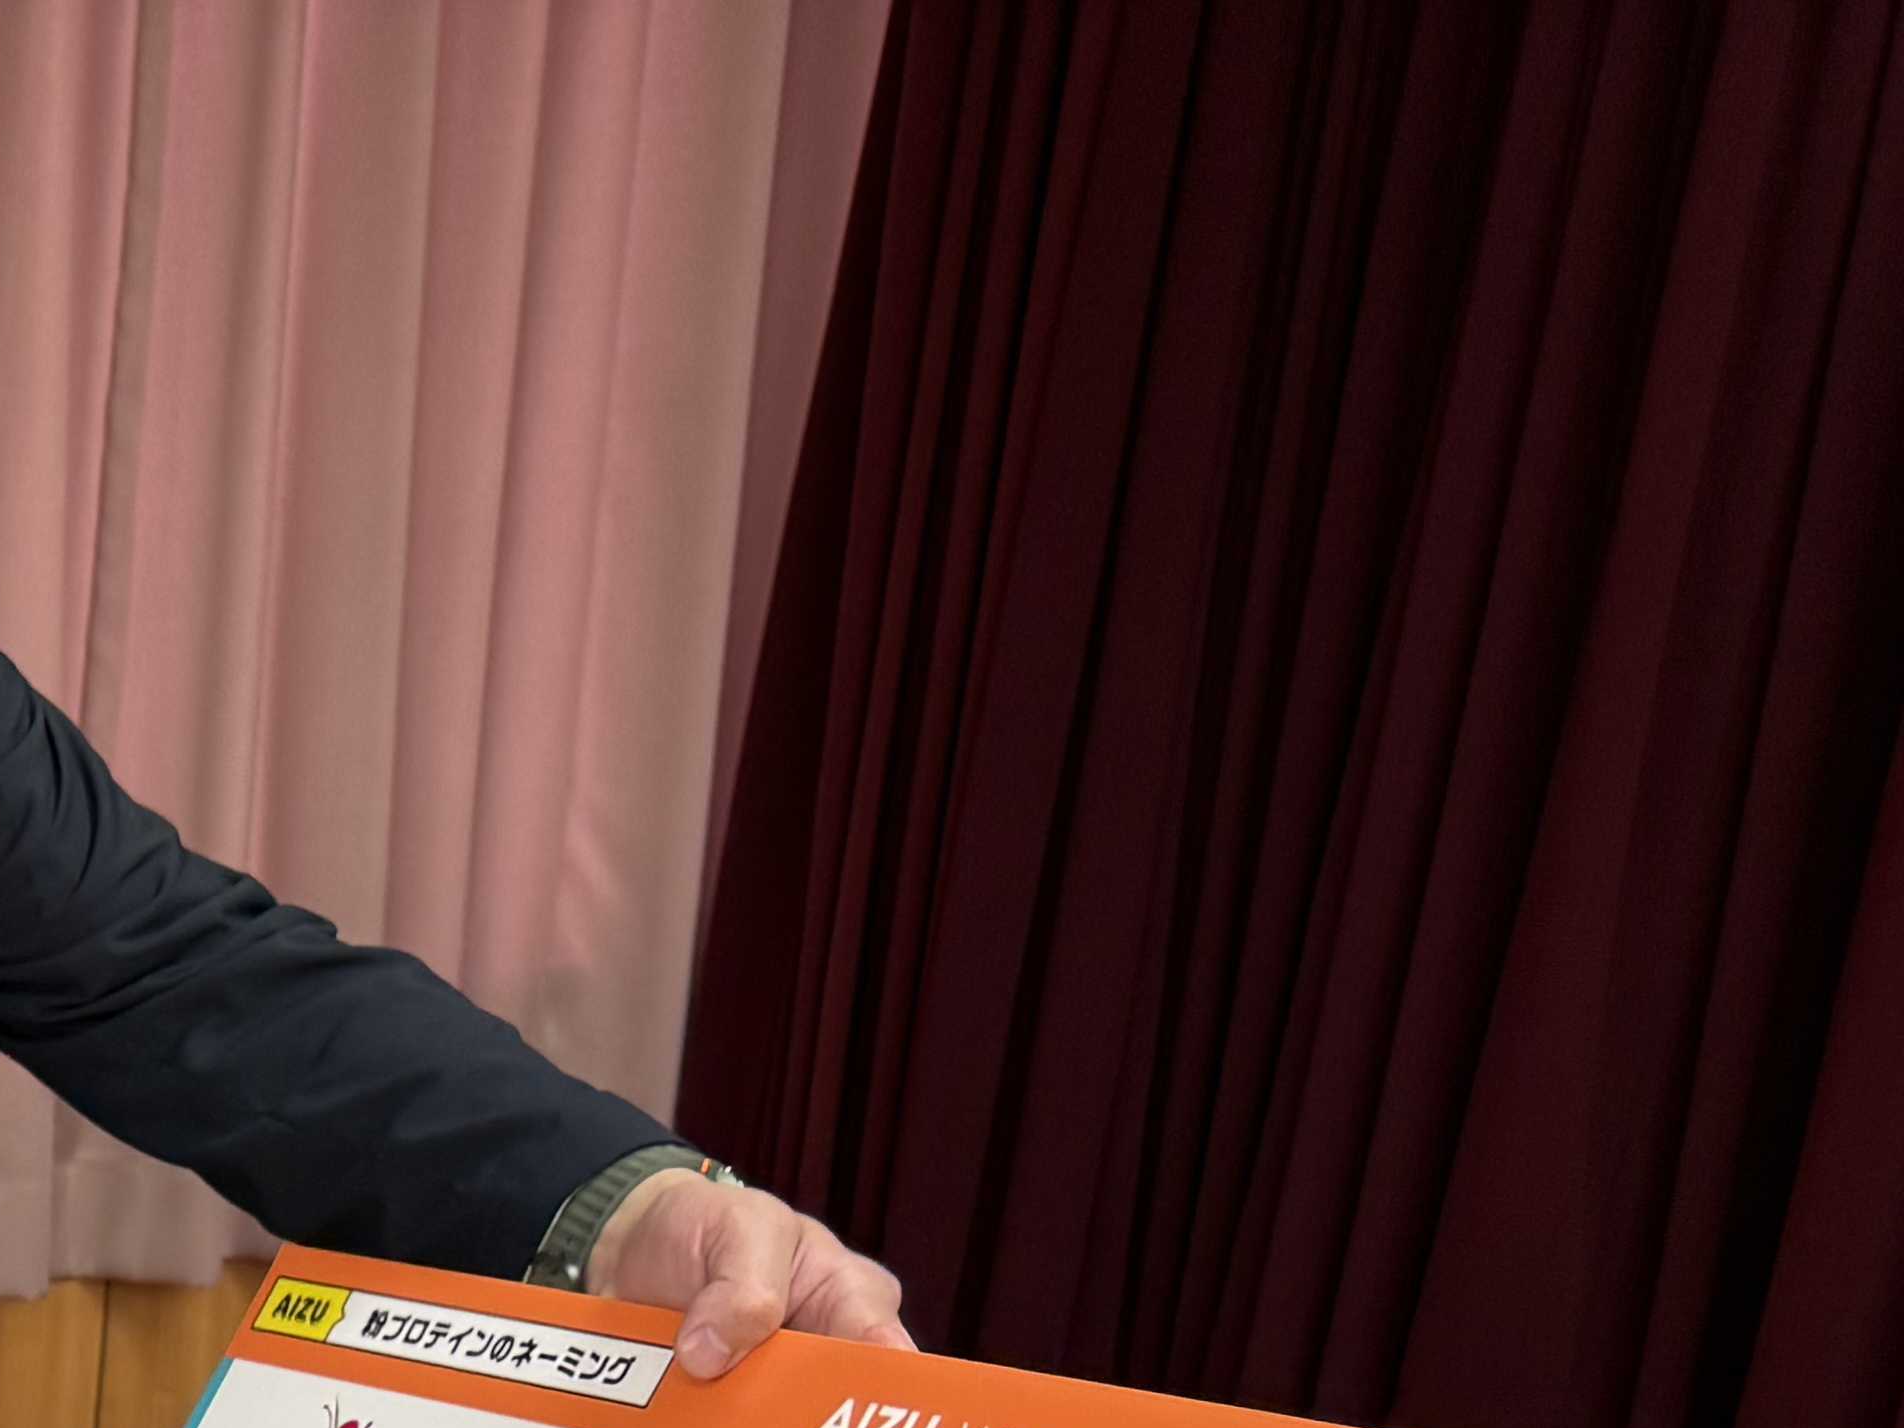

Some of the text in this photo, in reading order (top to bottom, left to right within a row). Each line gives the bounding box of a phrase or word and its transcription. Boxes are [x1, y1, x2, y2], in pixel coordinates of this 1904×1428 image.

[272, 1293, 331, 1324] AIZU
[362, 1309, 636, 1385] 粉プロテインのネーミング
